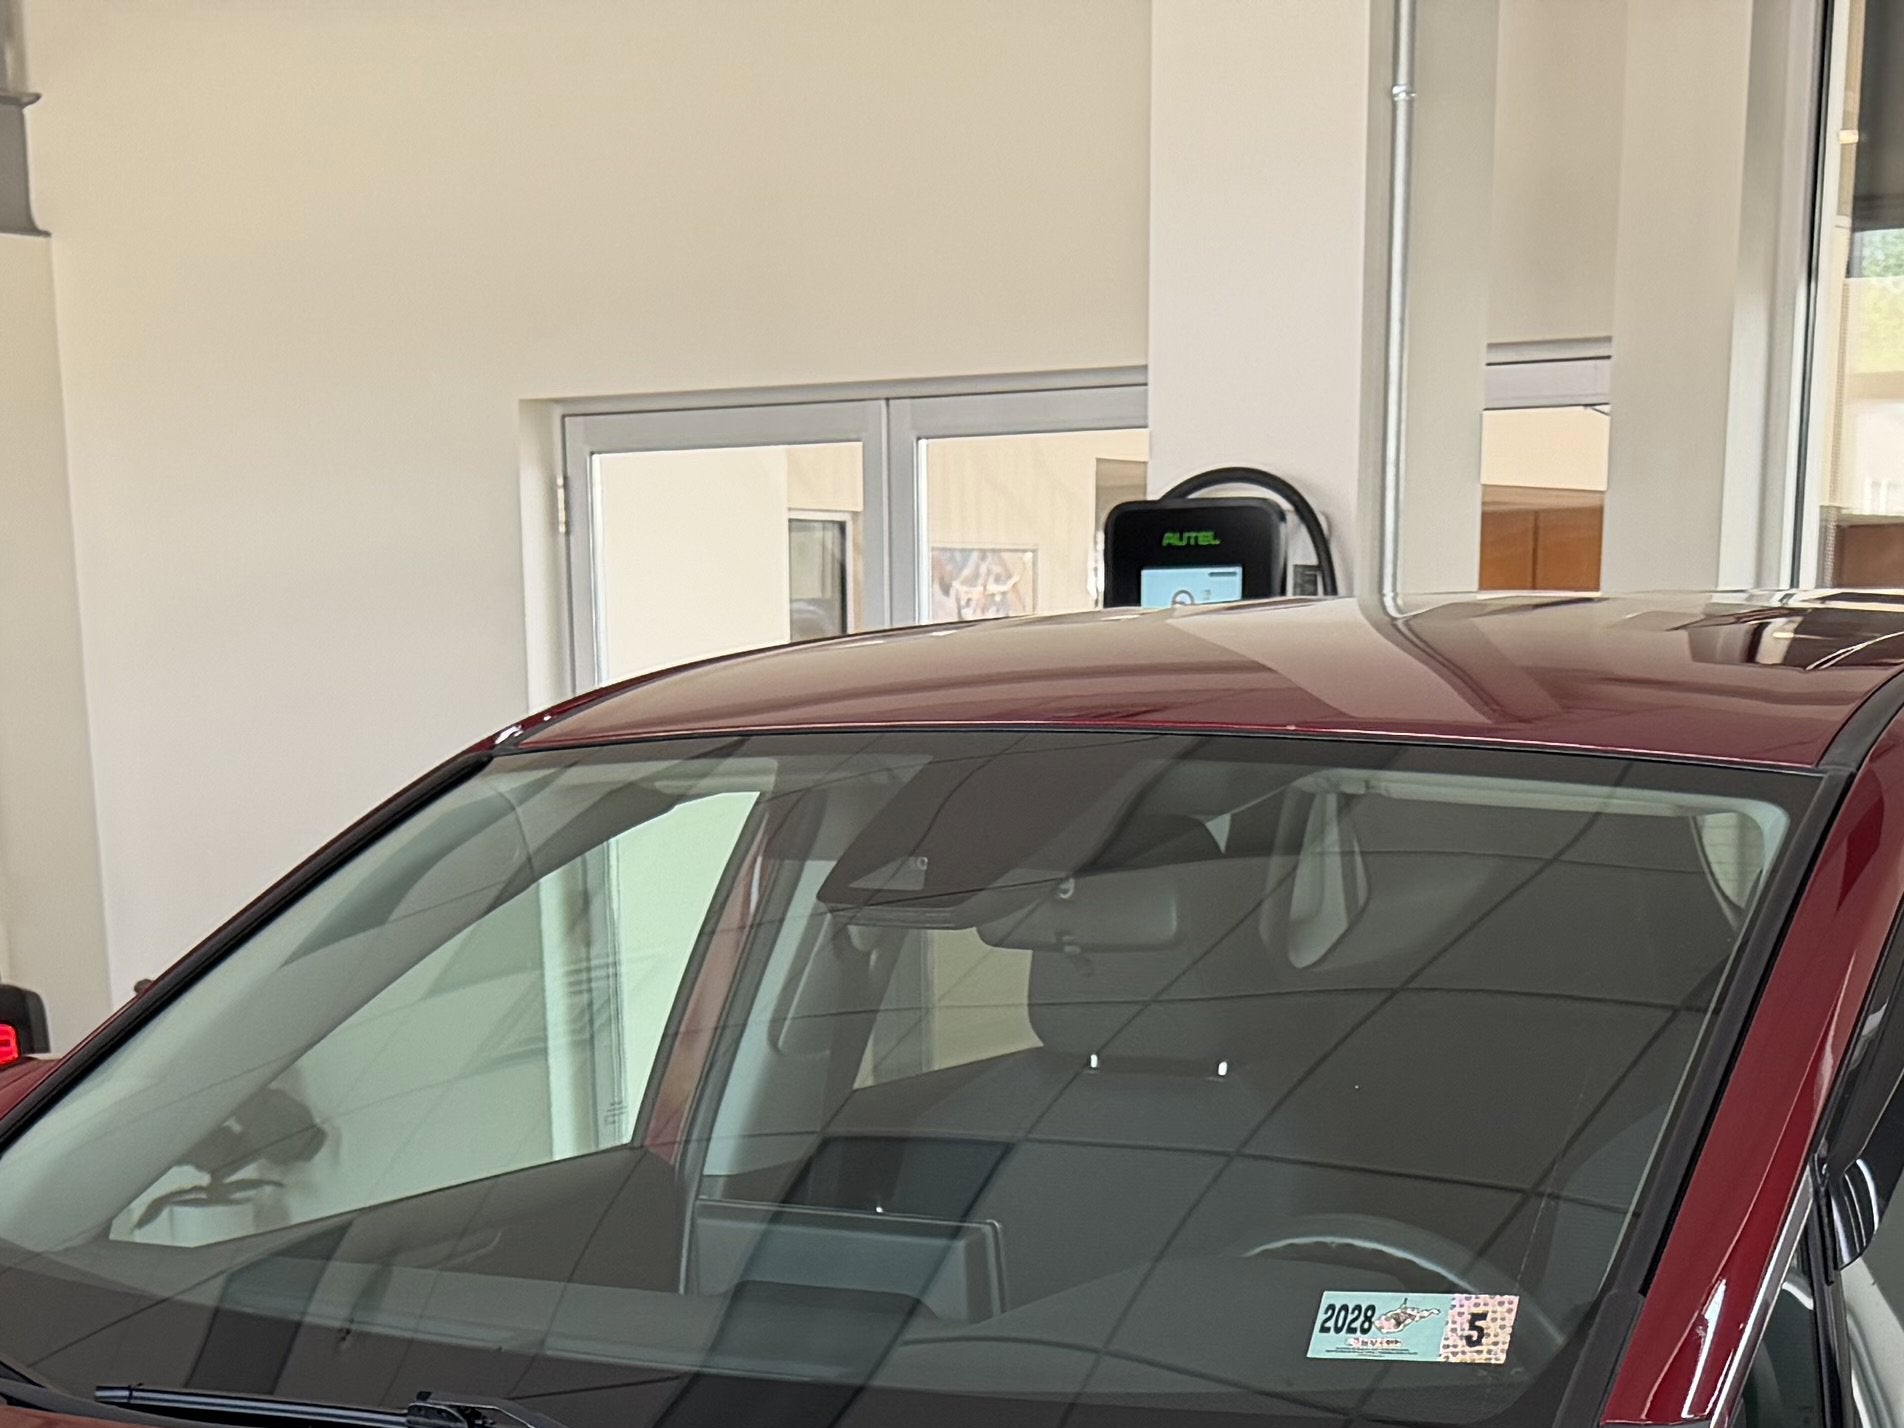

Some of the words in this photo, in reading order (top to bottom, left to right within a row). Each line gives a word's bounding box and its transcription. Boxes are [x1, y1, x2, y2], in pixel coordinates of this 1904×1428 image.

[1162, 531, 1220, 547] AUTEL
[1318, 1303, 1377, 1335] 2028
[1463, 1311, 1490, 1348] 5
